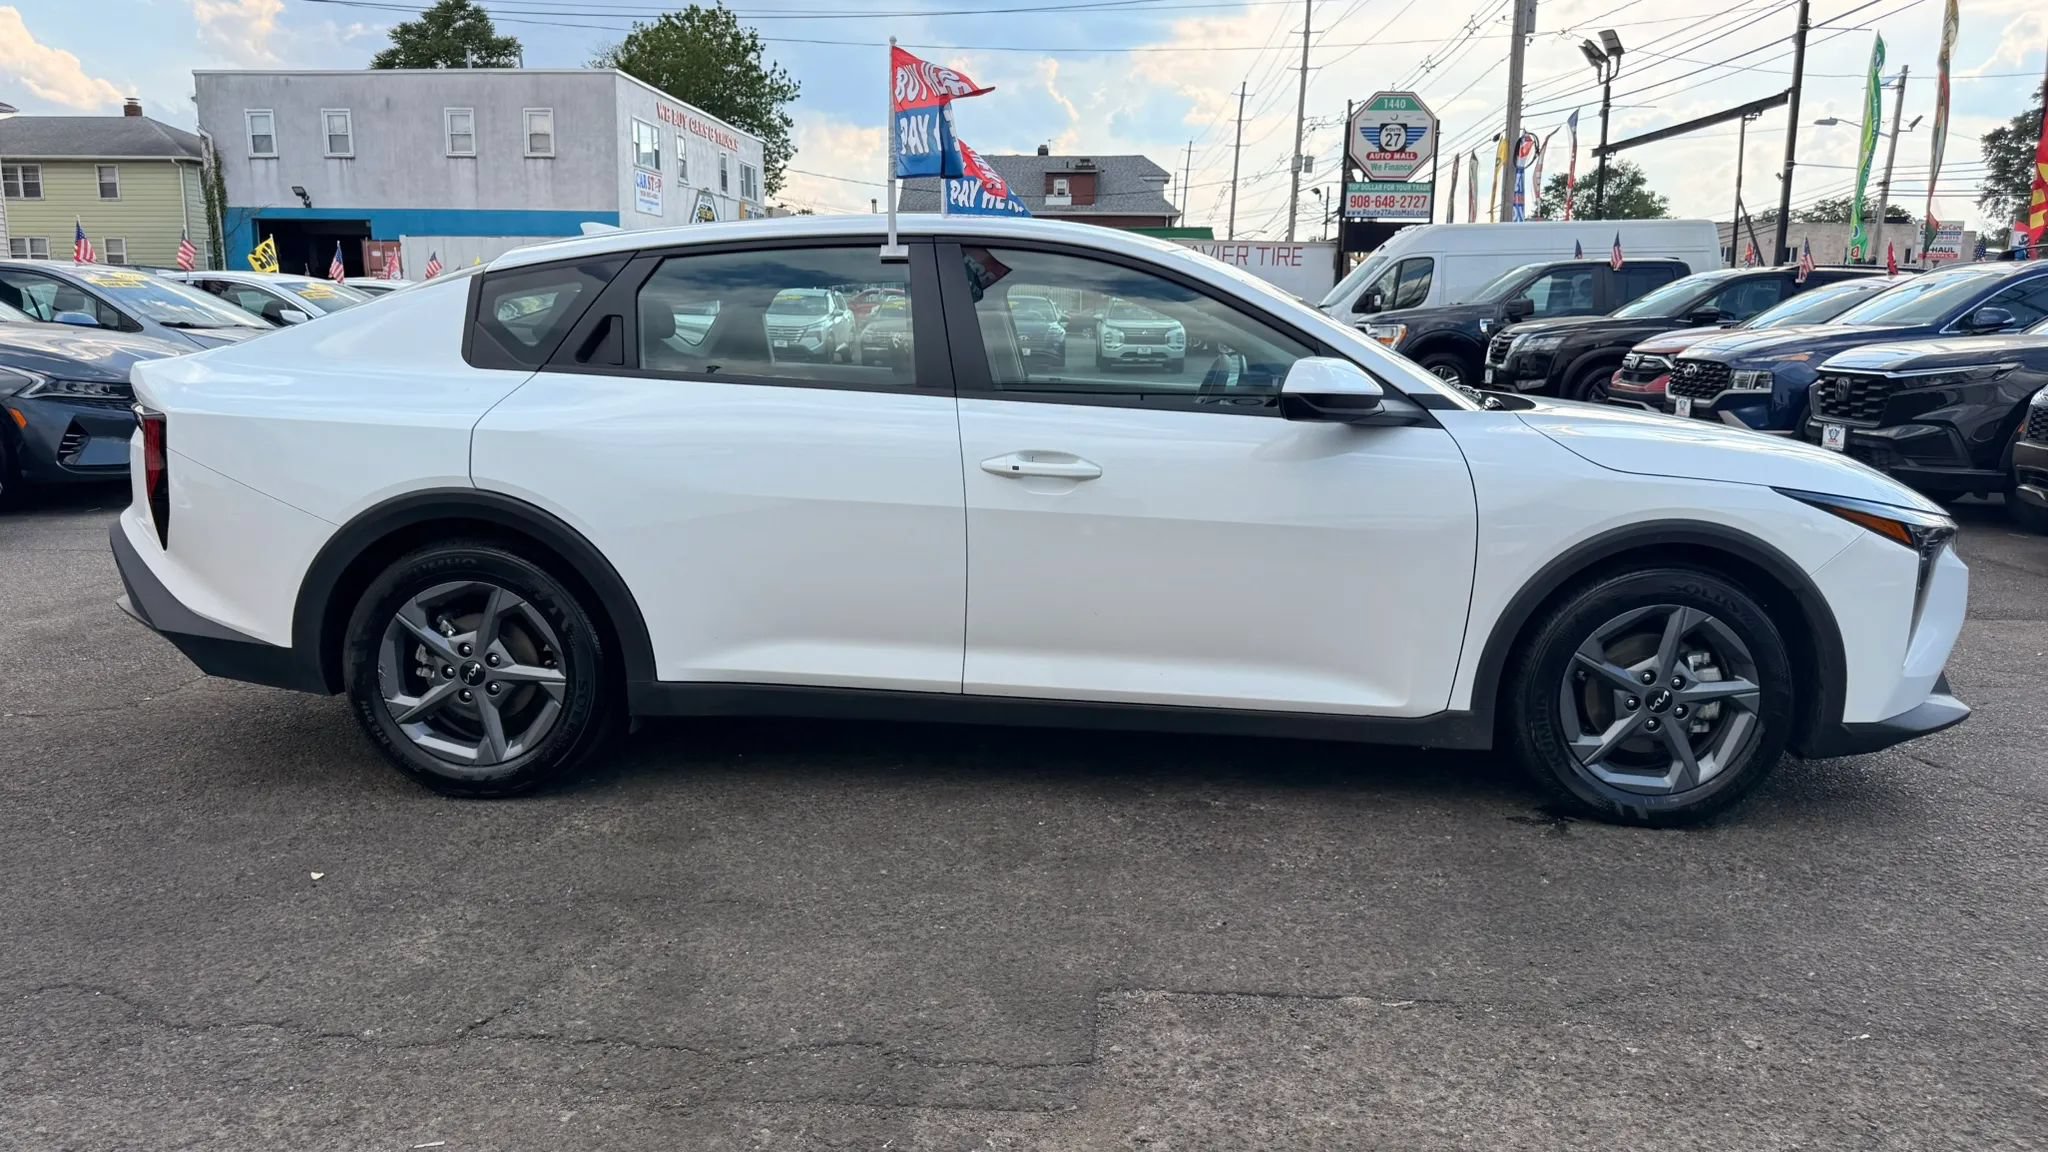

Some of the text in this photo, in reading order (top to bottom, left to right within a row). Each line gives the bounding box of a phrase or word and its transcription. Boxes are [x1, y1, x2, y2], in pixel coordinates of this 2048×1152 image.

[895, 63, 927, 103] BUY
[1384, 99, 1406, 109] 1440
[656, 102, 670, 123] WE
[672, 109, 687, 129] BUY
[689, 117, 708, 138] CARS
[715, 129, 739, 152] TRUCKS
[899, 114, 930, 155] PAY
[1384, 133, 1402, 147] 27
[1369, 152, 1415, 160] AUTO MALL
[1371, 163, 1413, 171] We Finance
[950, 177, 983, 207] PAY
[1350, 195, 1428, 208] 908-648-2727
[1190, 245, 1304, 266] VIER TIRE
